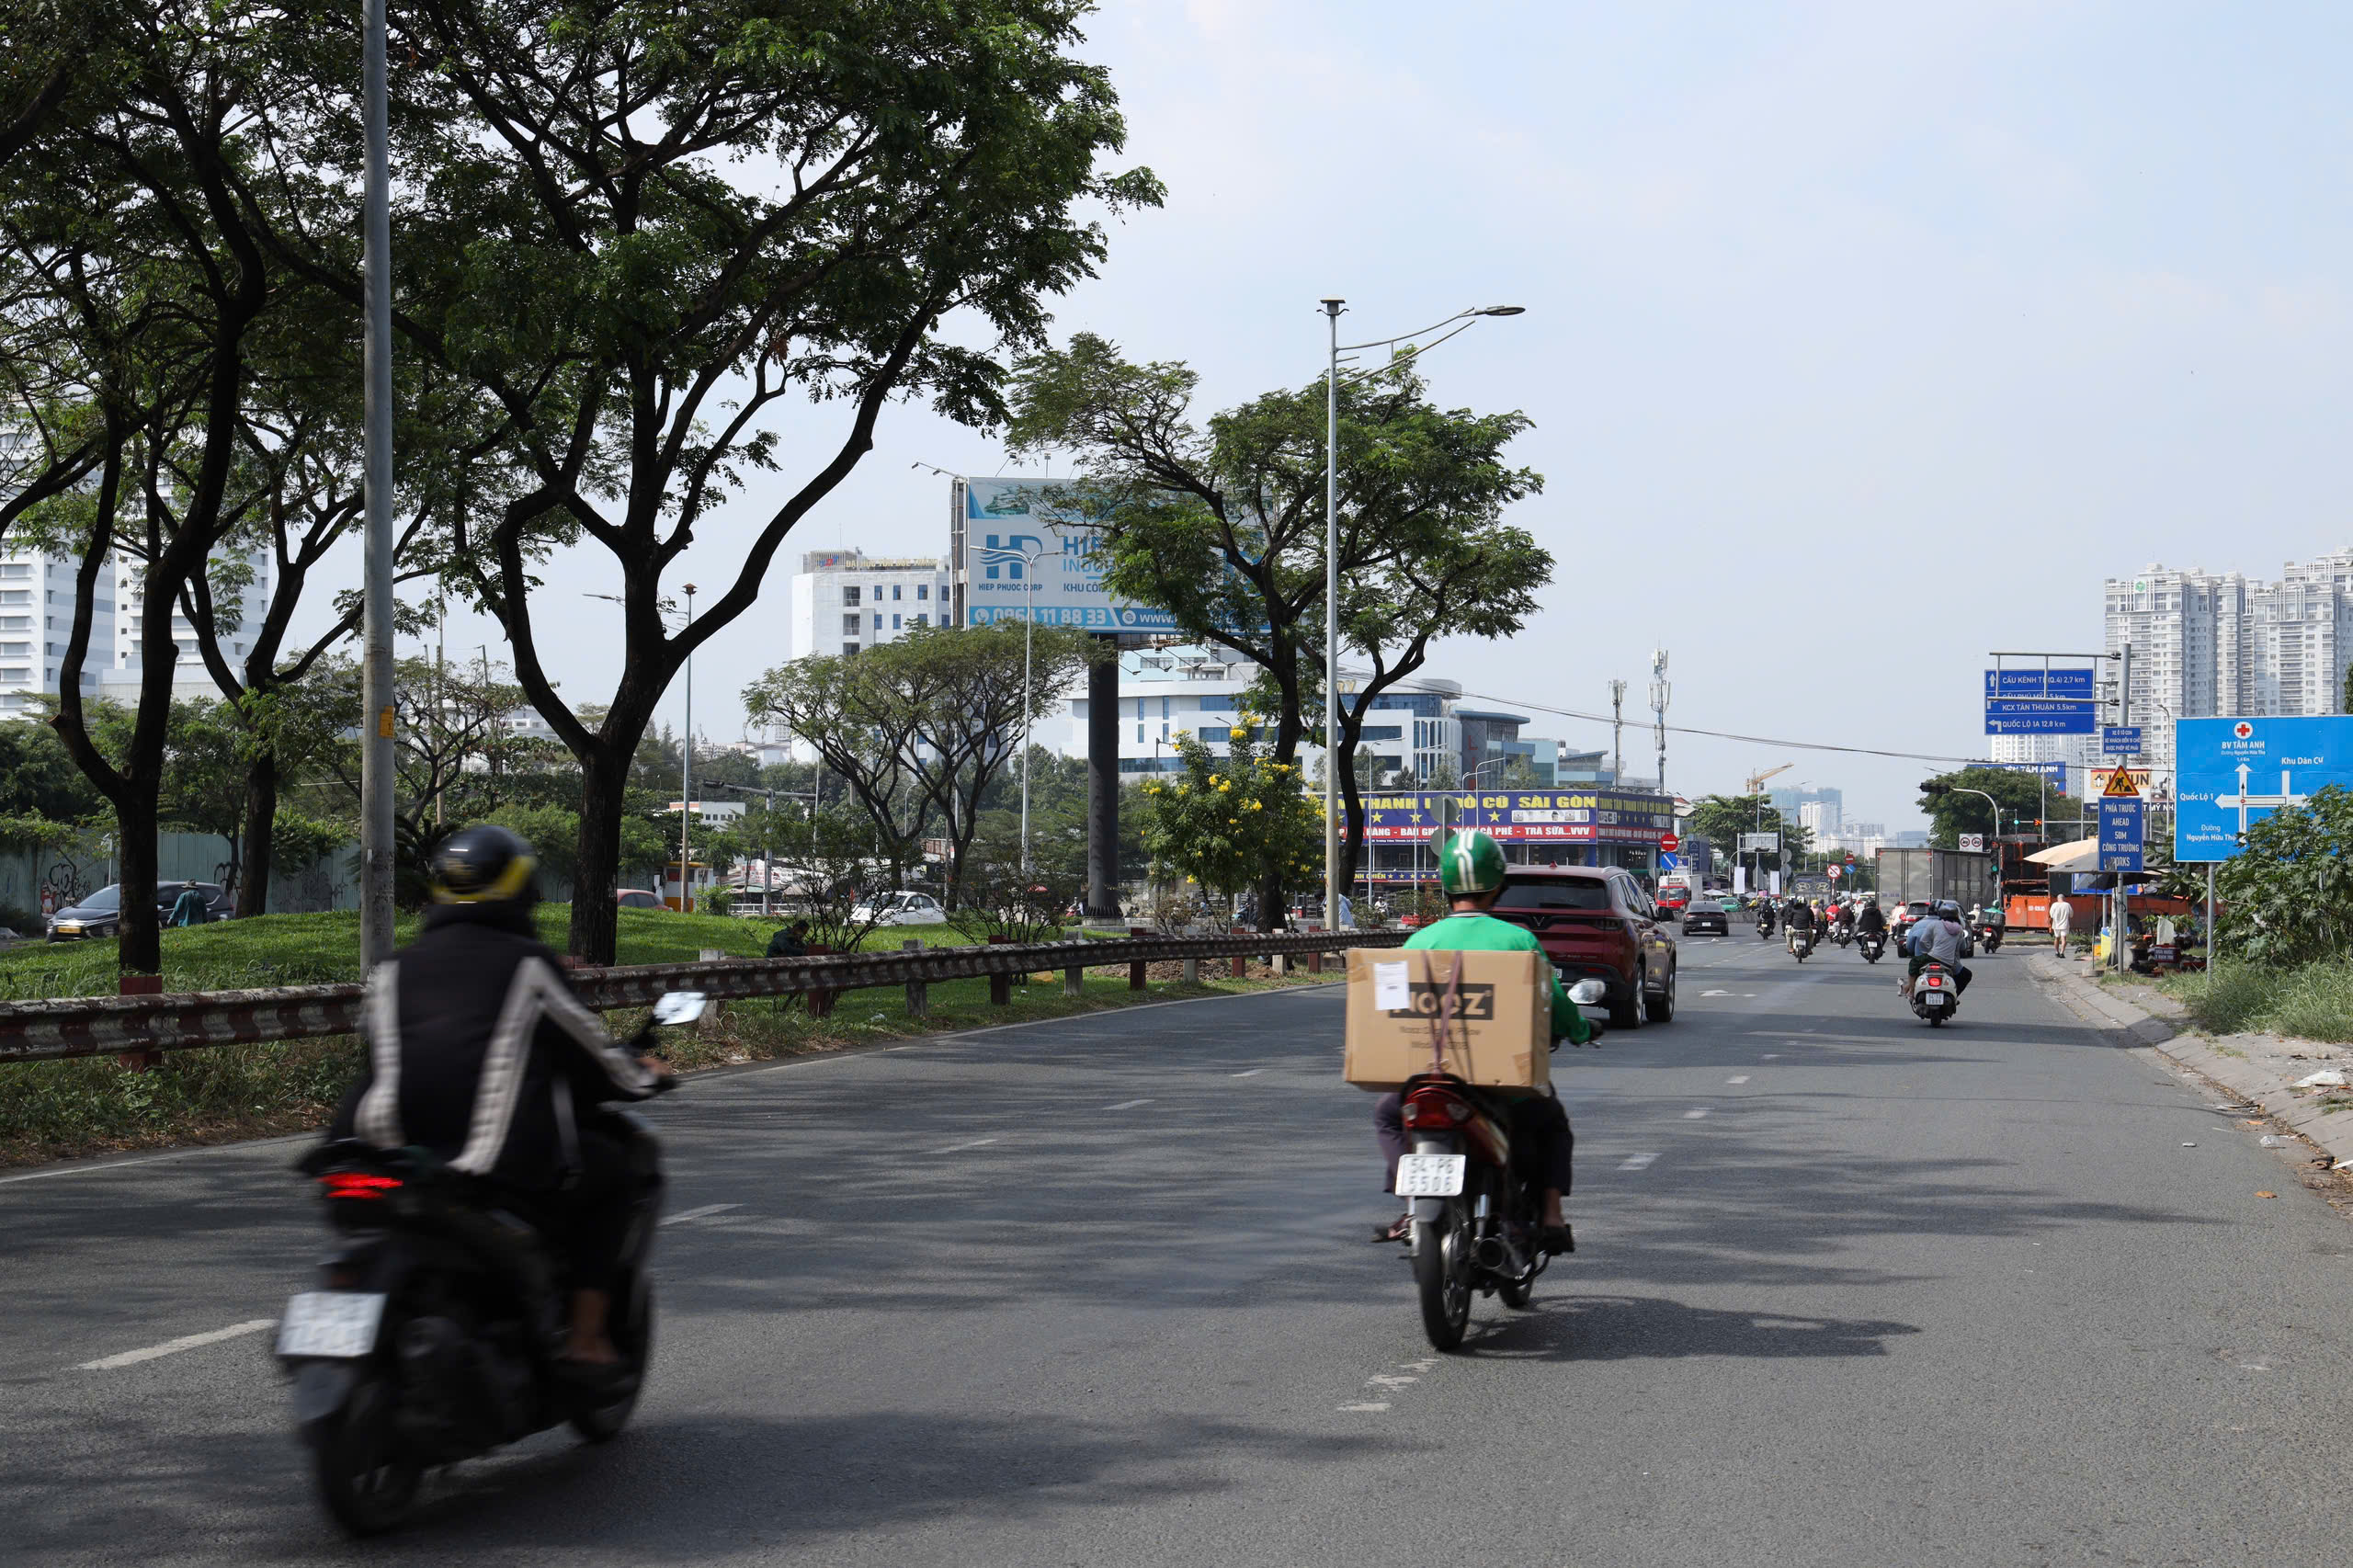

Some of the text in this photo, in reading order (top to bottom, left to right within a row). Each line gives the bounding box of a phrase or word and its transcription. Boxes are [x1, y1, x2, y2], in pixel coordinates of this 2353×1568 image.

[978, 583, 995, 591] HIEP
[996, 583, 1022, 591] PHUOC
[1063, 583, 1085, 593] KHU
[1061, 608, 1083, 625] 88
[1086, 608, 1106, 625] 33
[2018, 675, 2037, 684] KÊNH
[2016, 703, 2030, 711] TÂN
[2002, 719, 2021, 728] QUỐC
[2222, 740, 2265, 749] BV TÂM ANH
[2281, 756, 2296, 765] Khu
[2297, 756, 2313, 765] Dân
[2040, 765, 2059, 773] ANH
[2180, 791, 2199, 802] Quốc
[2200, 792, 2209, 801] Lộ
[1483, 795, 1509, 809] CŨ
[1518, 794, 1551, 809] SÀI
[1556, 794, 1597, 809] GÒN
[2105, 802, 2118, 813] PHÍA
[2119, 802, 2136, 813] TRƯỚC
[2111, 818, 2130, 826] AHEAD
[1495, 825, 1513, 835] PHÊ
[1524, 825, 1543, 835] TRÀ
[2114, 831, 2127, 840] 50M
[2186, 833, 2209, 843] Nguyễn
[2211, 833, 2223, 841] Hữu
[2102, 843, 2117, 852] CÔNG
